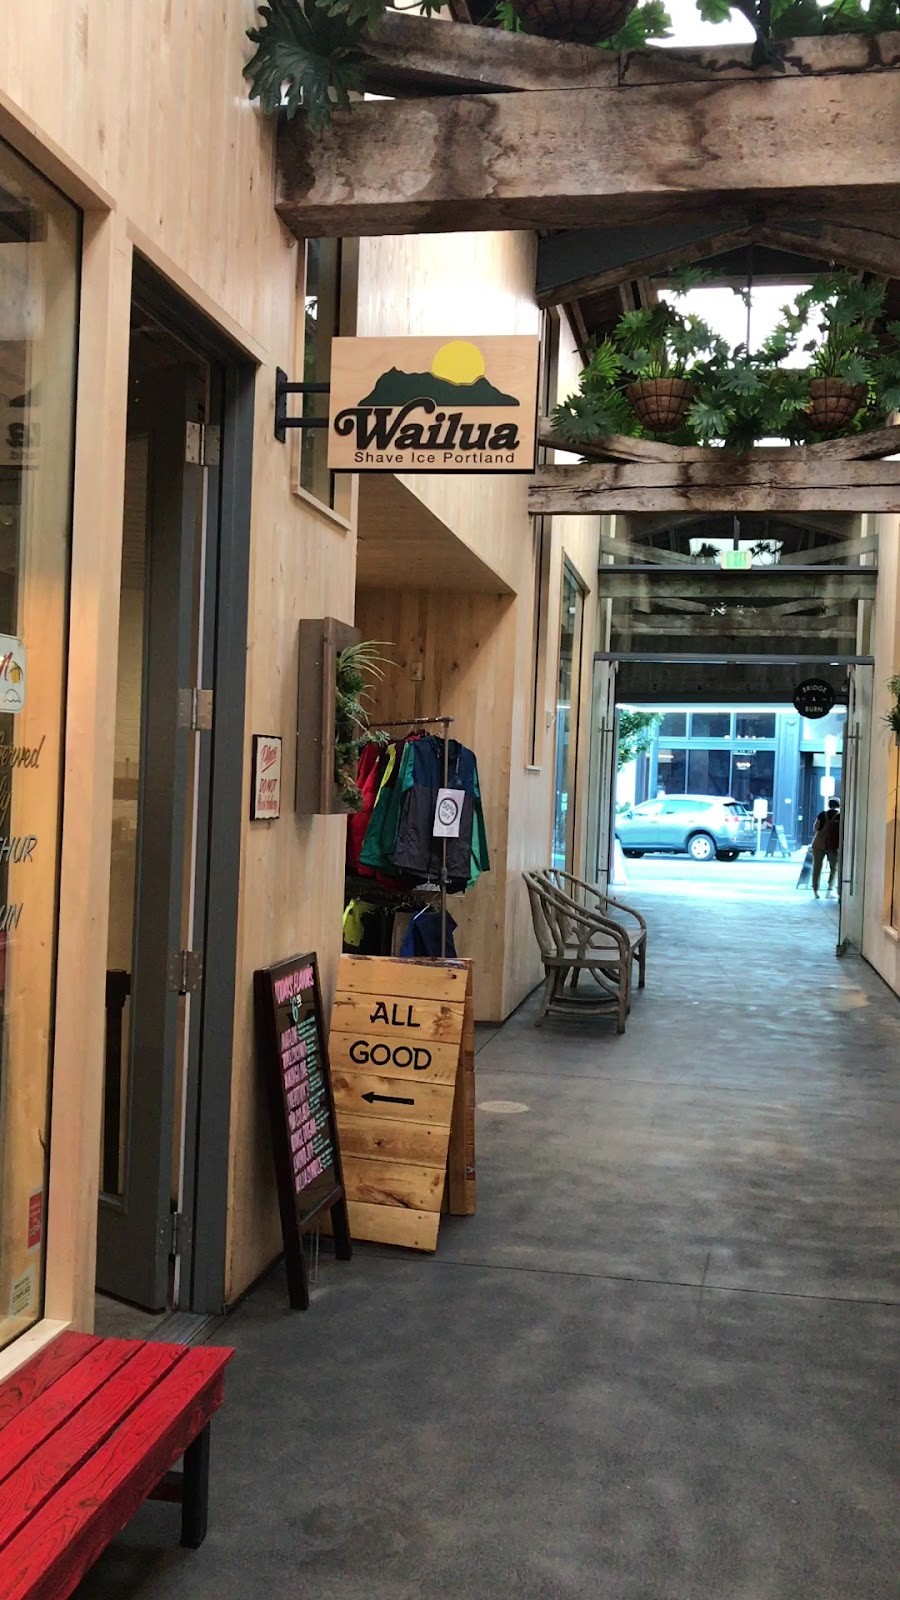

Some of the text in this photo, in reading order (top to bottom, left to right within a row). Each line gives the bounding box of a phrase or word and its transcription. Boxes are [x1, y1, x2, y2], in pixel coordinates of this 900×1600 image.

[334, 397, 520, 451] Wailua
[354, 451, 515, 463] Shave Ice Portland
[802, 684, 828, 693] BRIDGE
[369, 1001, 421, 1027] ALL
[349, 1039, 432, 1070] GOOD
